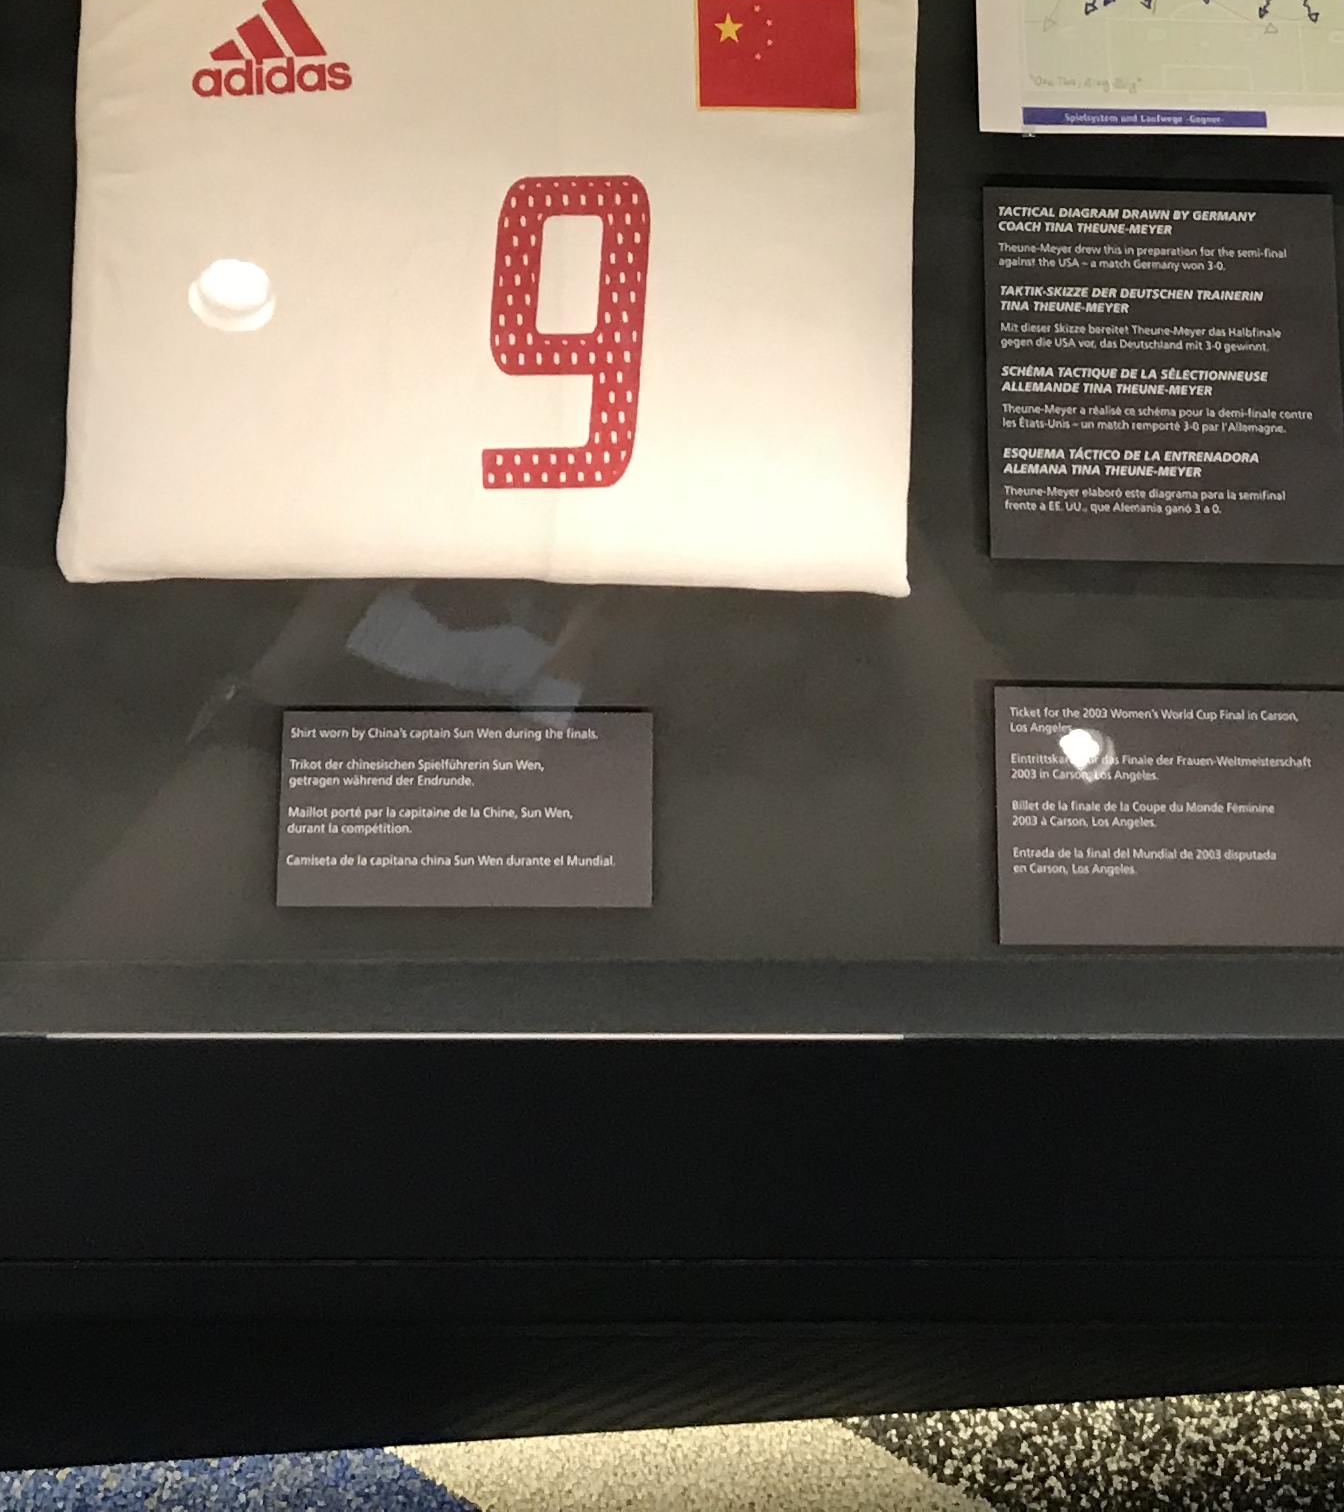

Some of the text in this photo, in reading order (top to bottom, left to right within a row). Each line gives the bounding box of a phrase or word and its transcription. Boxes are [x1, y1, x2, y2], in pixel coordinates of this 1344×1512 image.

[191, 55, 353, 98] adidas
[997, 205, 1256, 222] TACTICAL DIAGRAM DRAWN BY GERMANY
[997, 220, 1172, 235] COACH TINA THEUNE-MEYER
[482, 175, 652, 490] 9
[1009, 706, 1299, 722] Ticket for the 2003 Women's World Cup Final in Carson,
[290, 726, 598, 741] Shirt worn by China's captain Sun Wen during the finals.
